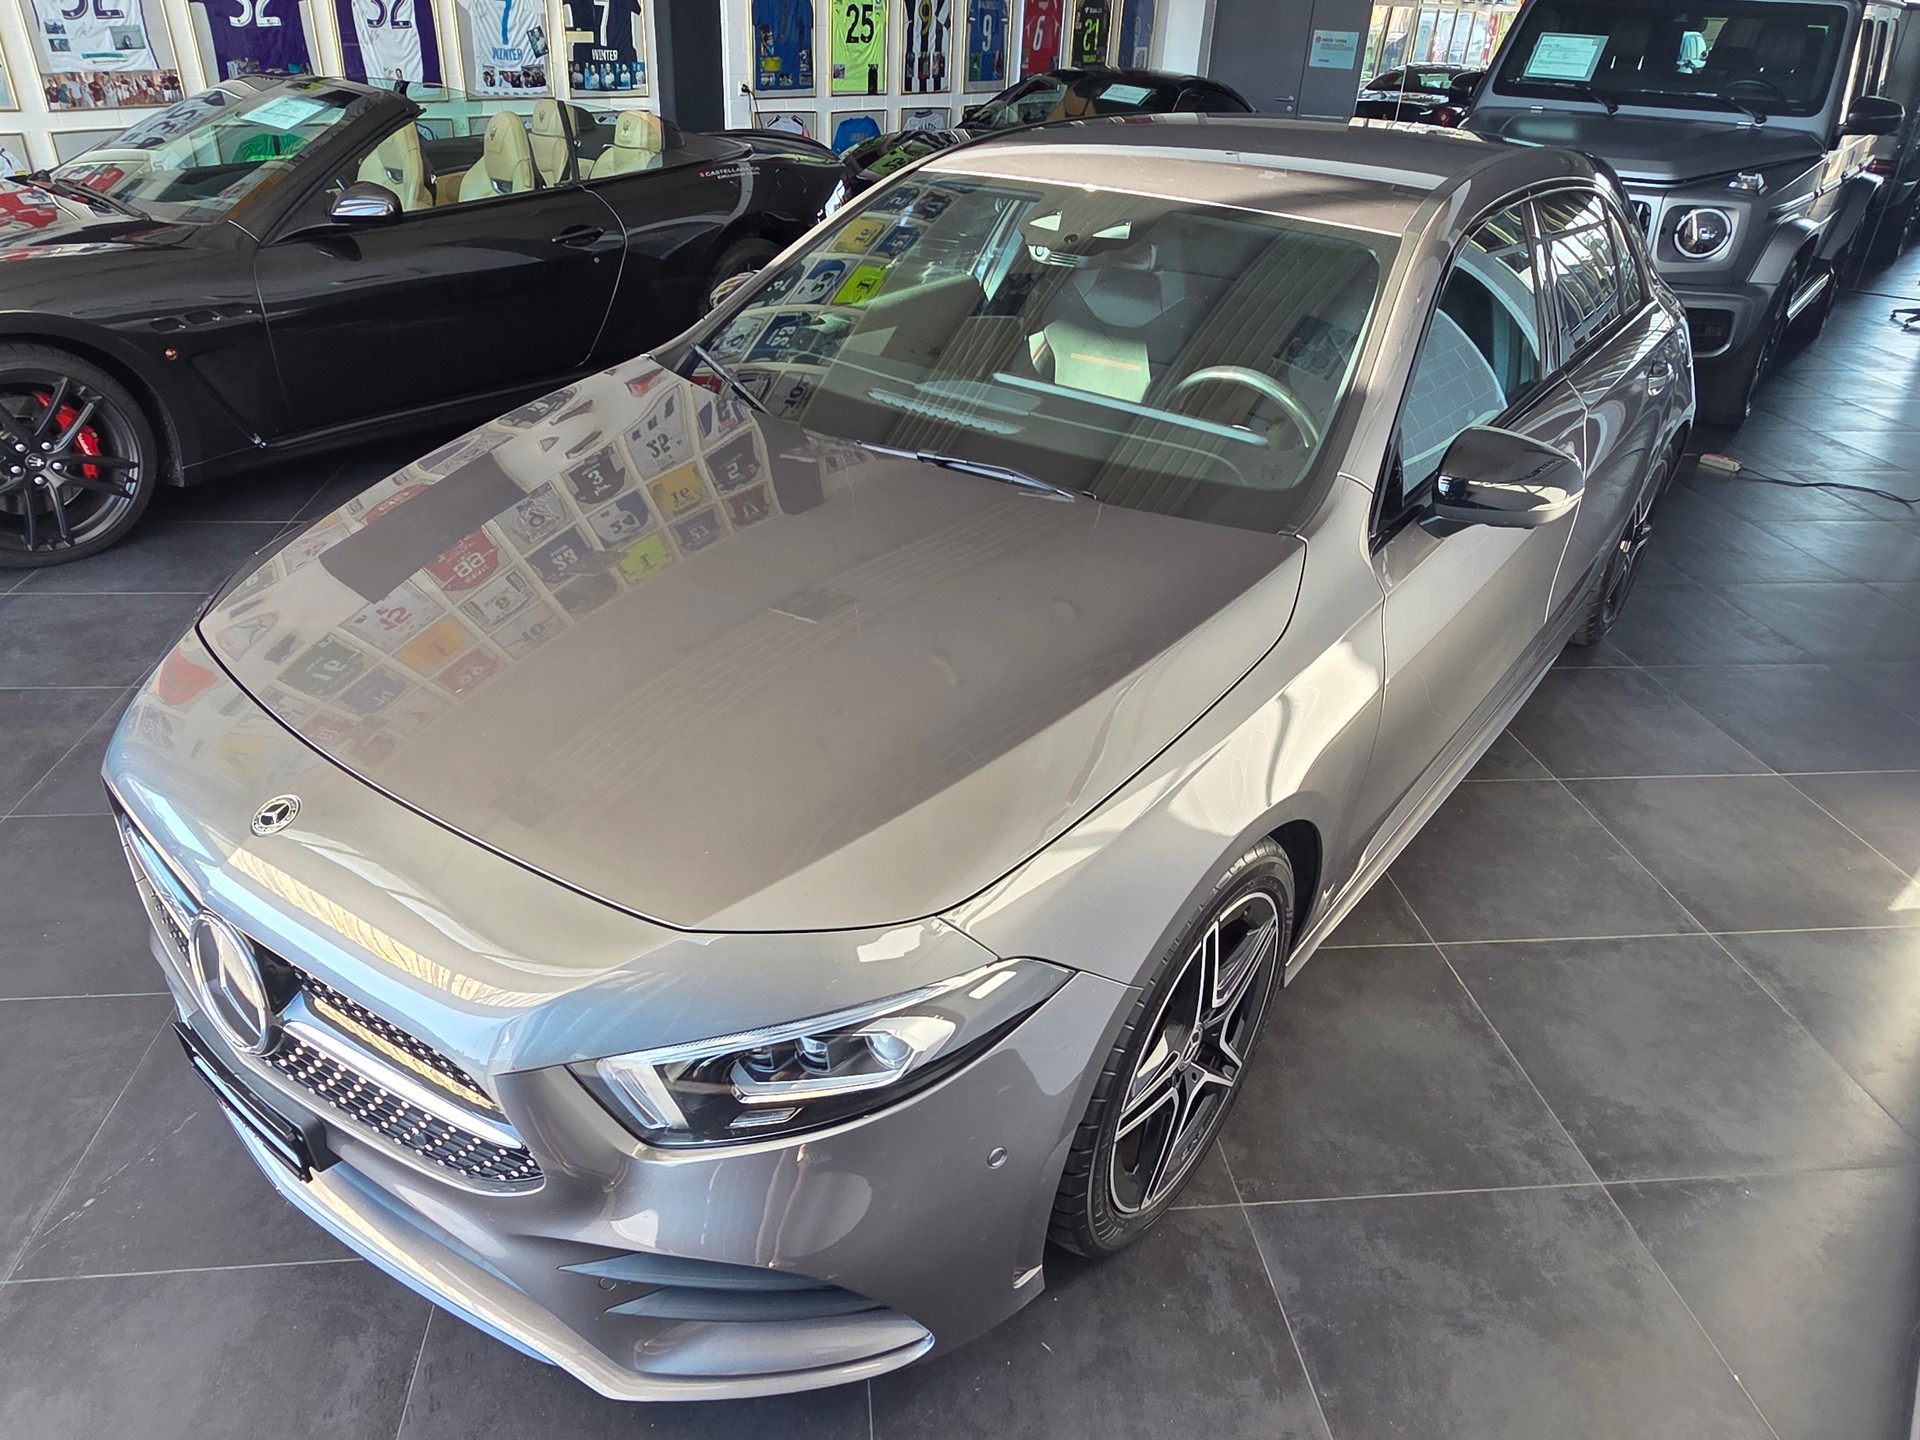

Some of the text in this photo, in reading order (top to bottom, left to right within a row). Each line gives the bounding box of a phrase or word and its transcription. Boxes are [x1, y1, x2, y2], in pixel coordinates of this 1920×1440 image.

[594, 0, 610, 47] 7
[845, 3, 875, 44] 25
[918, 0, 932, 35] 9
[982, 14, 993, 52] 9
[1032, 15, 1046, 51] 6
[1083, 18, 1100, 51] 21
[492, 47, 524, 62] WINTER
[591, 49, 618, 61] WINTER
